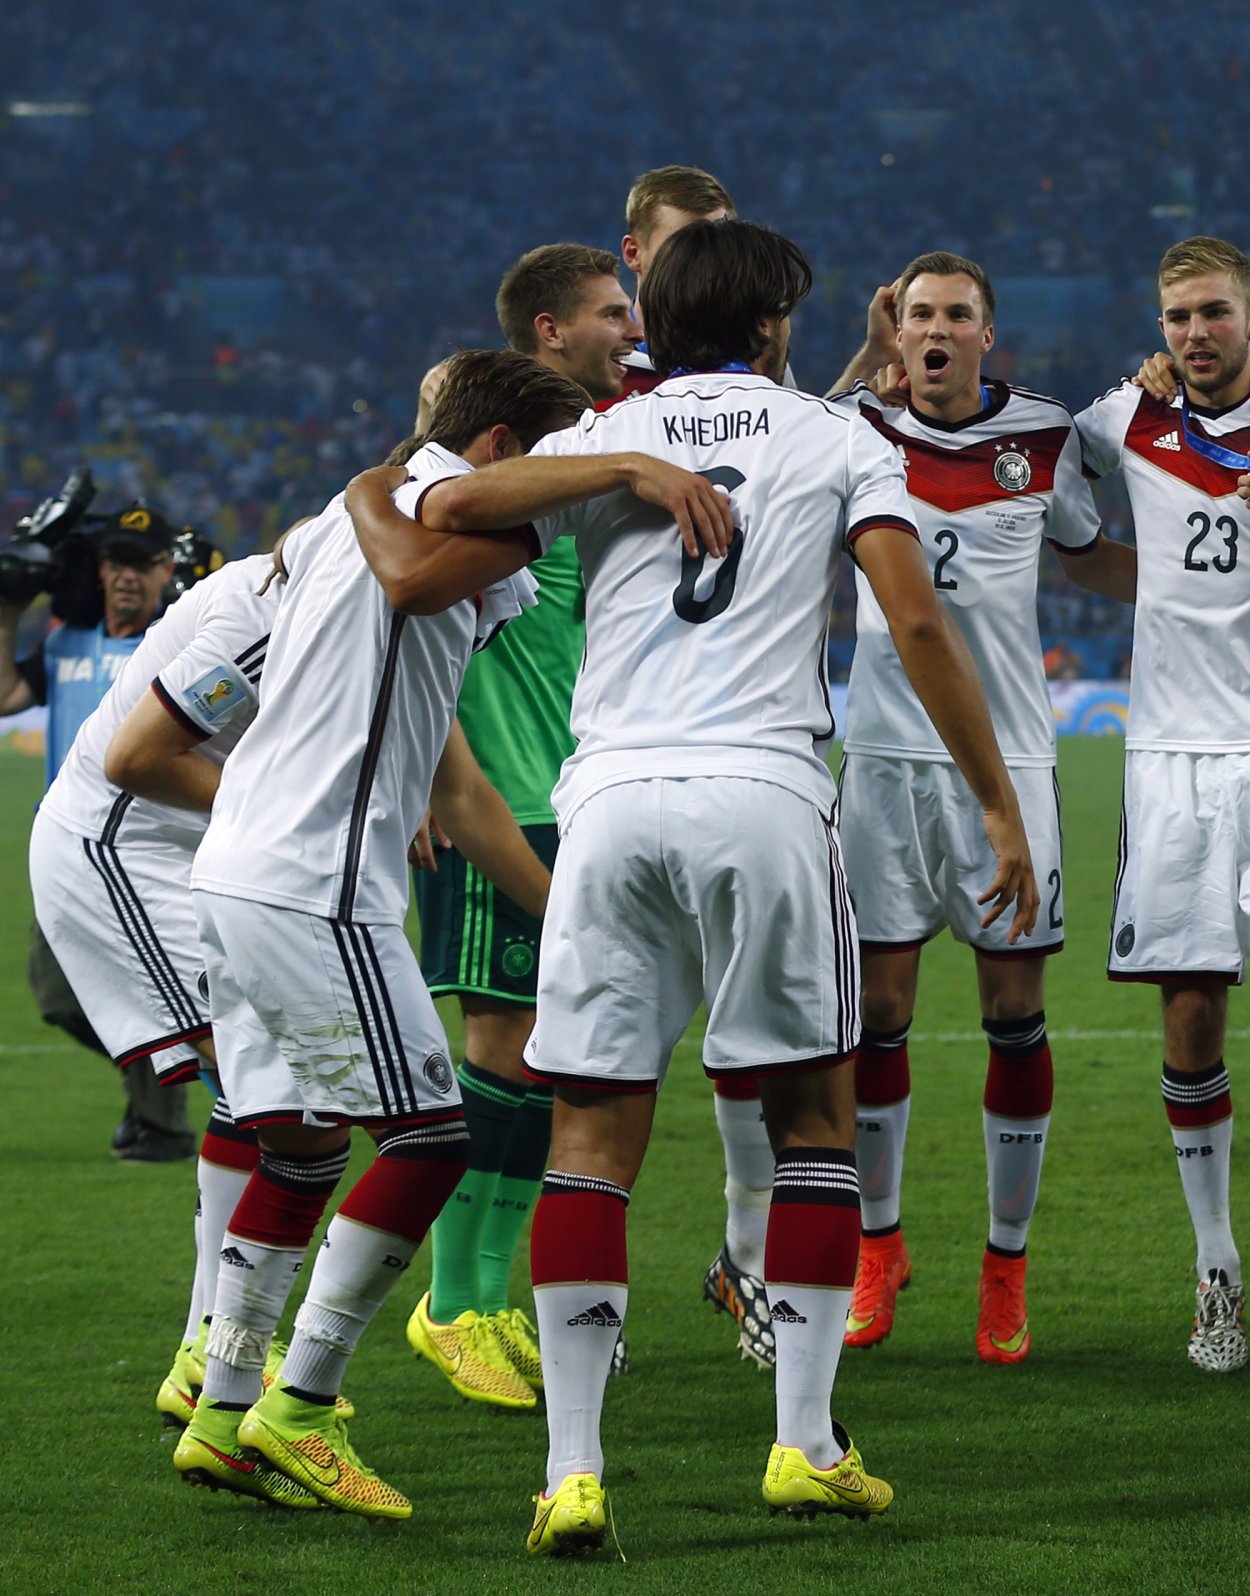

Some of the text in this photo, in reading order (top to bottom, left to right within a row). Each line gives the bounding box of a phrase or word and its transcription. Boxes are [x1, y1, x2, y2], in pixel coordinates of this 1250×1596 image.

[663, 408, 769, 446] KHEDIRA
[1153, 440, 1182, 452] adidas
[1184, 511, 1239, 573] 23
[934, 529, 958, 590] 2
[1048, 869, 1063, 930] 2
[999, 1133, 1043, 1144] DFB
[1174, 1145, 1214, 1159] DFB
[567, 1317, 622, 1328] adidas
